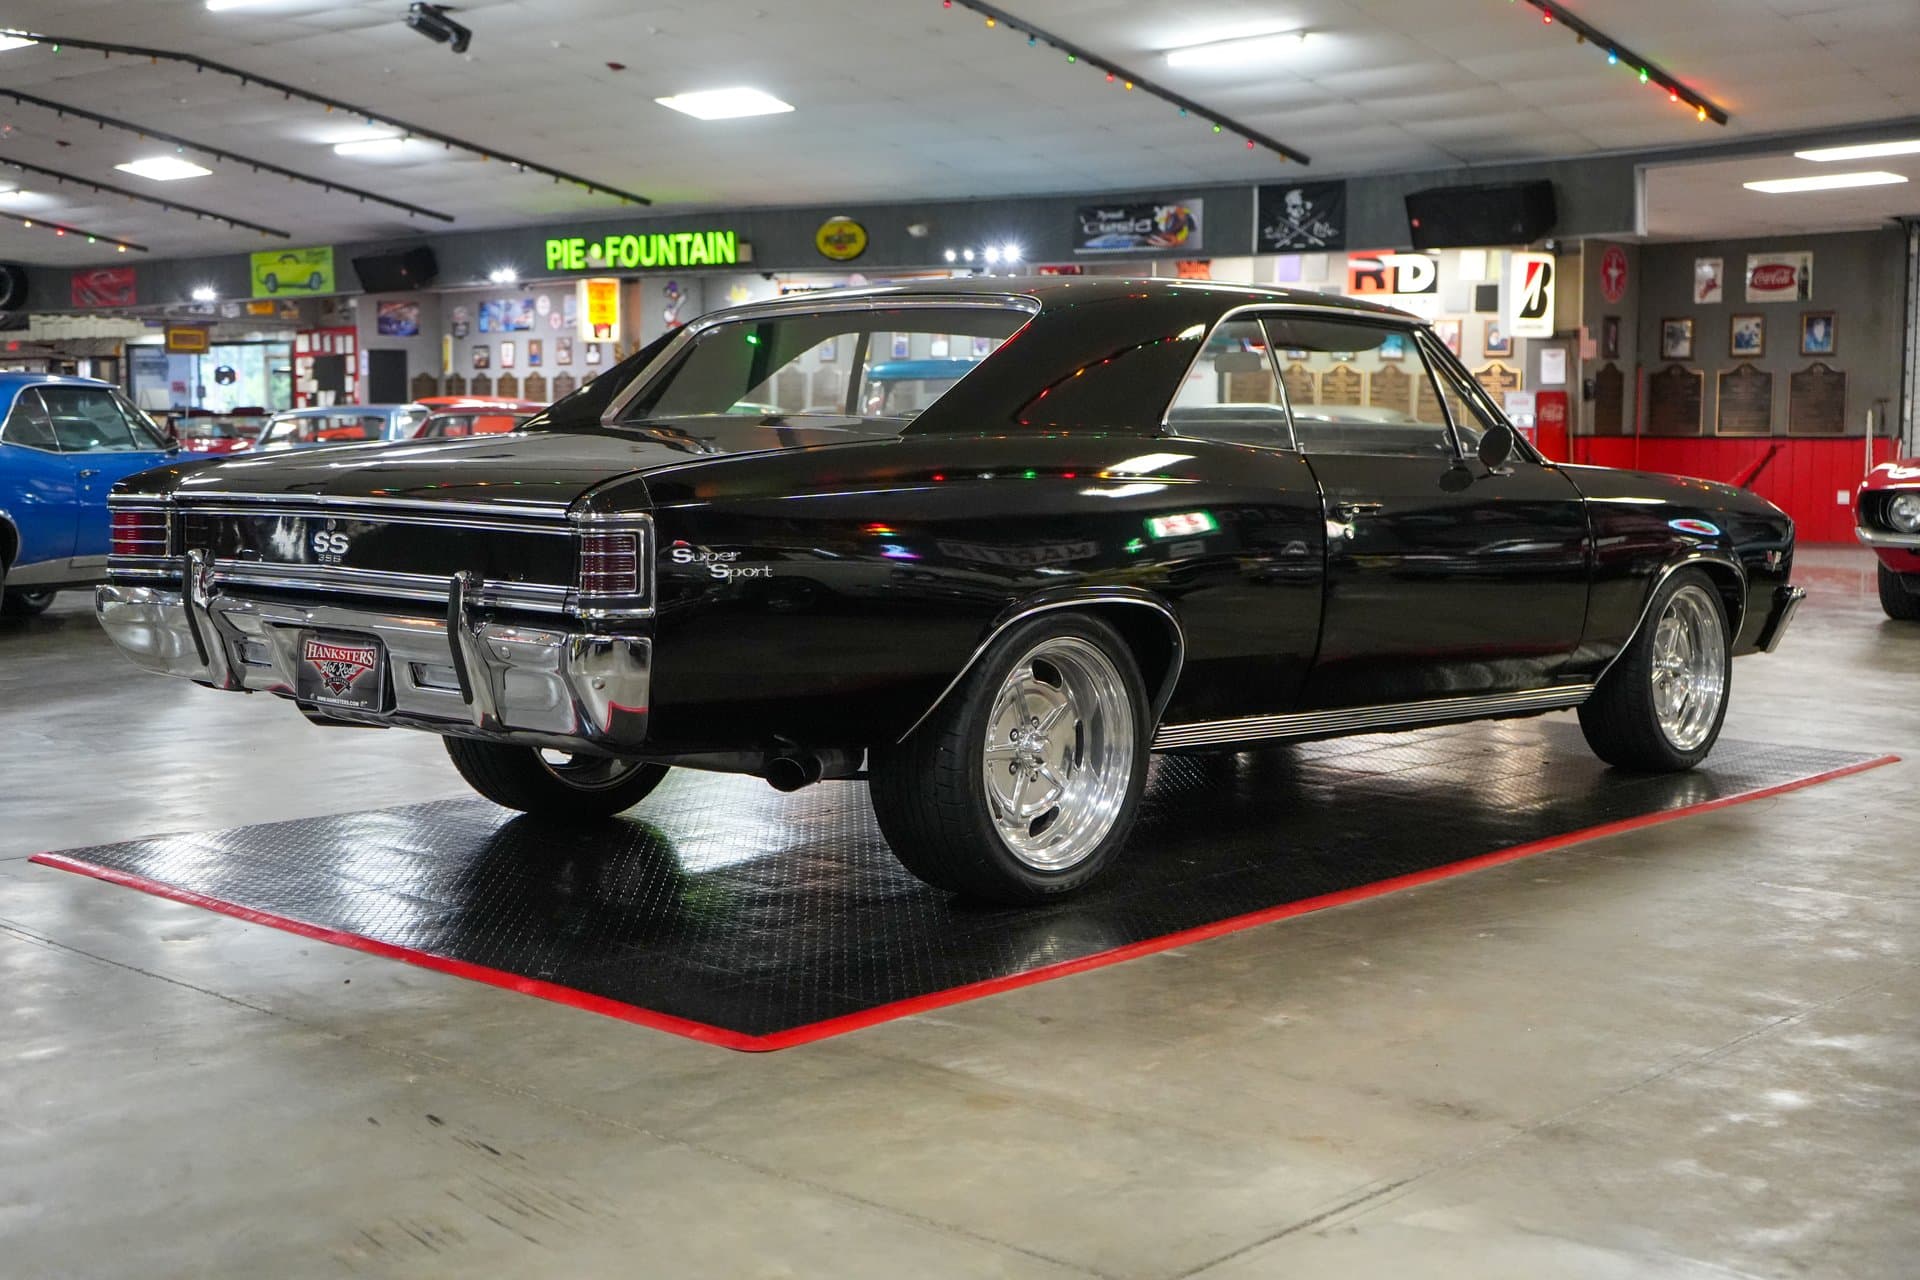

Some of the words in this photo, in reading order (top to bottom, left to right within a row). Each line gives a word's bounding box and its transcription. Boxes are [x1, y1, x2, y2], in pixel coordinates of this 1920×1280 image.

[546, 238, 586, 270] PIE
[605, 231, 736, 268] FOUNTAIN
[313, 531, 349, 554] SS
[672, 548, 741, 568] Super
[710, 563, 773, 584] Sport
[307, 644, 373, 665] HANKSTERS
